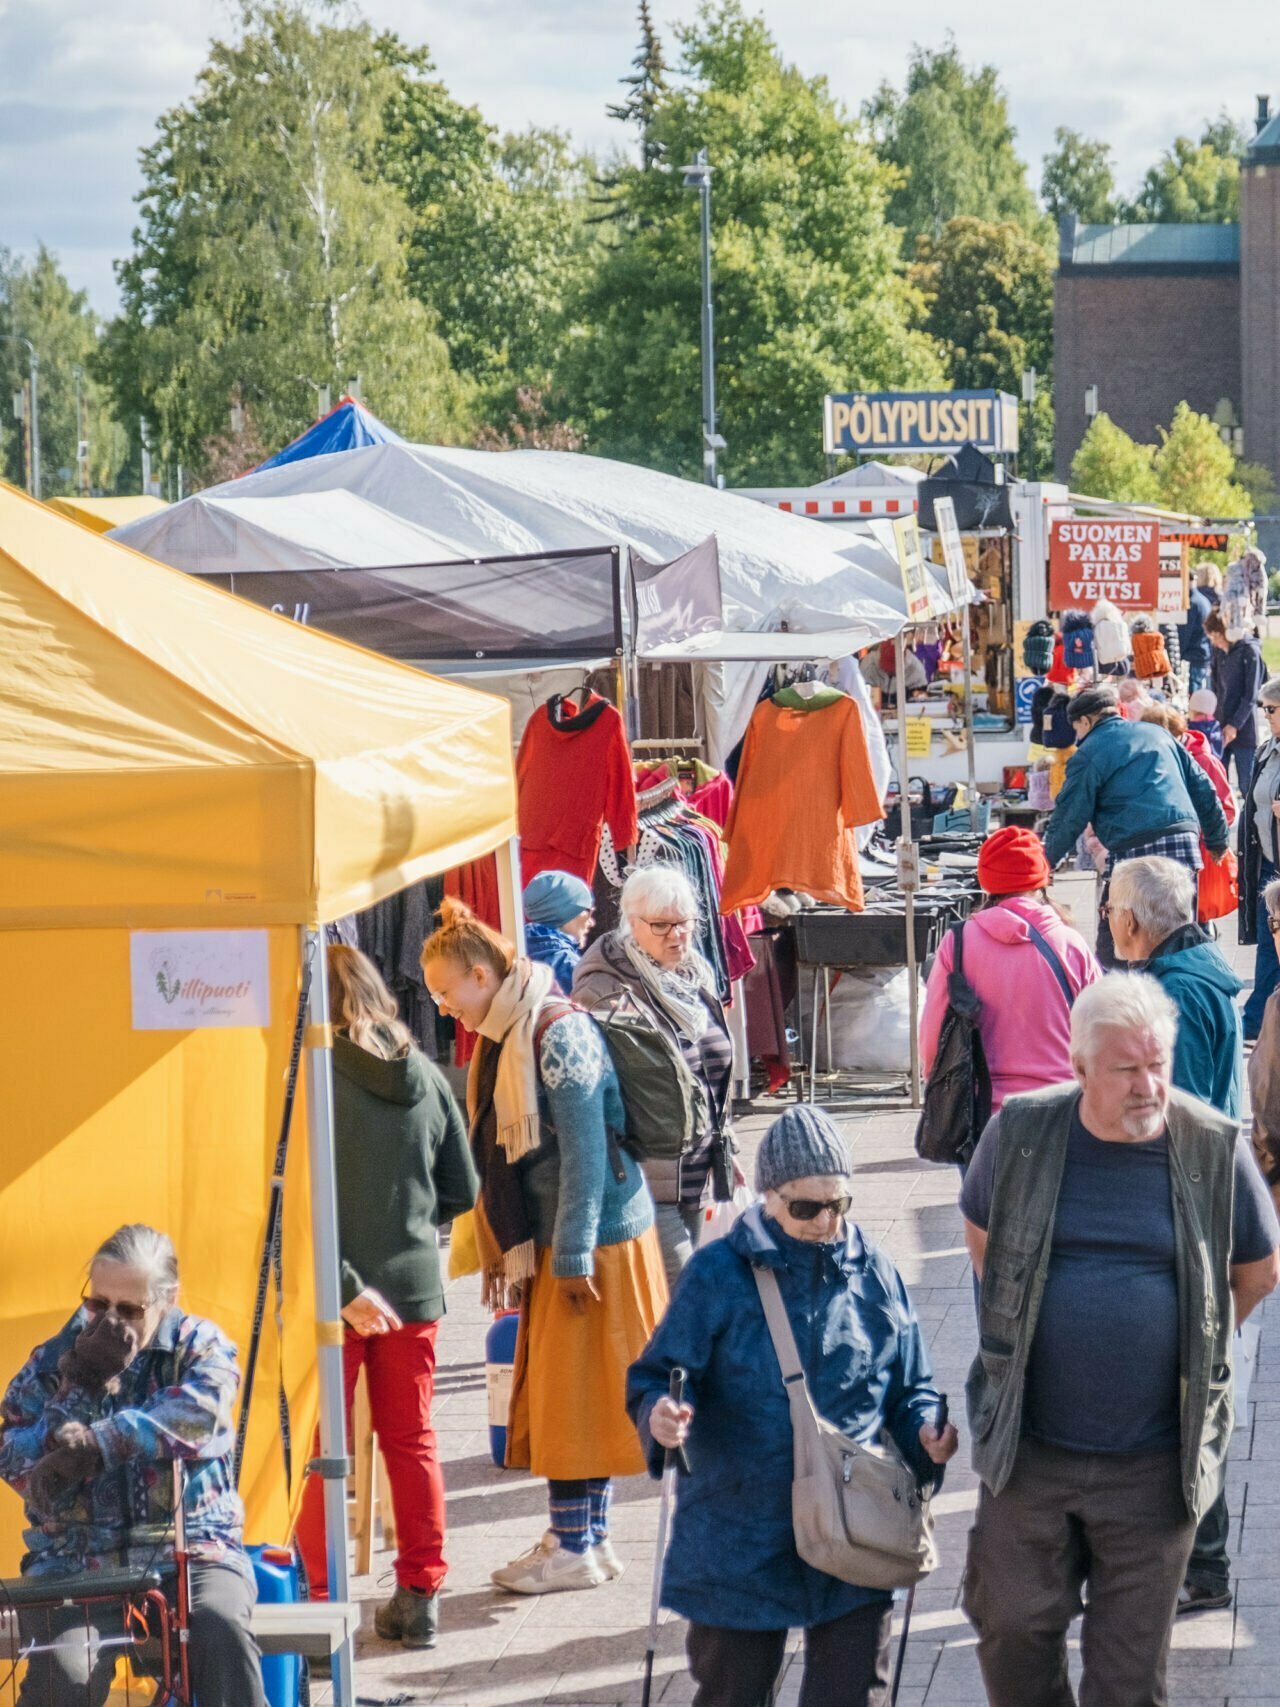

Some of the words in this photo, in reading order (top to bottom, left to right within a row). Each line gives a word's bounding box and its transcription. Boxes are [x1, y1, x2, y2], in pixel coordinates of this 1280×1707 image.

[833, 395, 992, 443] PÖLYPUSSIT
[1058, 524, 1153, 542] SUOMEN
[1068, 544, 1142, 561] PARAS
[1081, 562, 1128, 580] FILE
[1068, 582, 1141, 600] VEITSI
